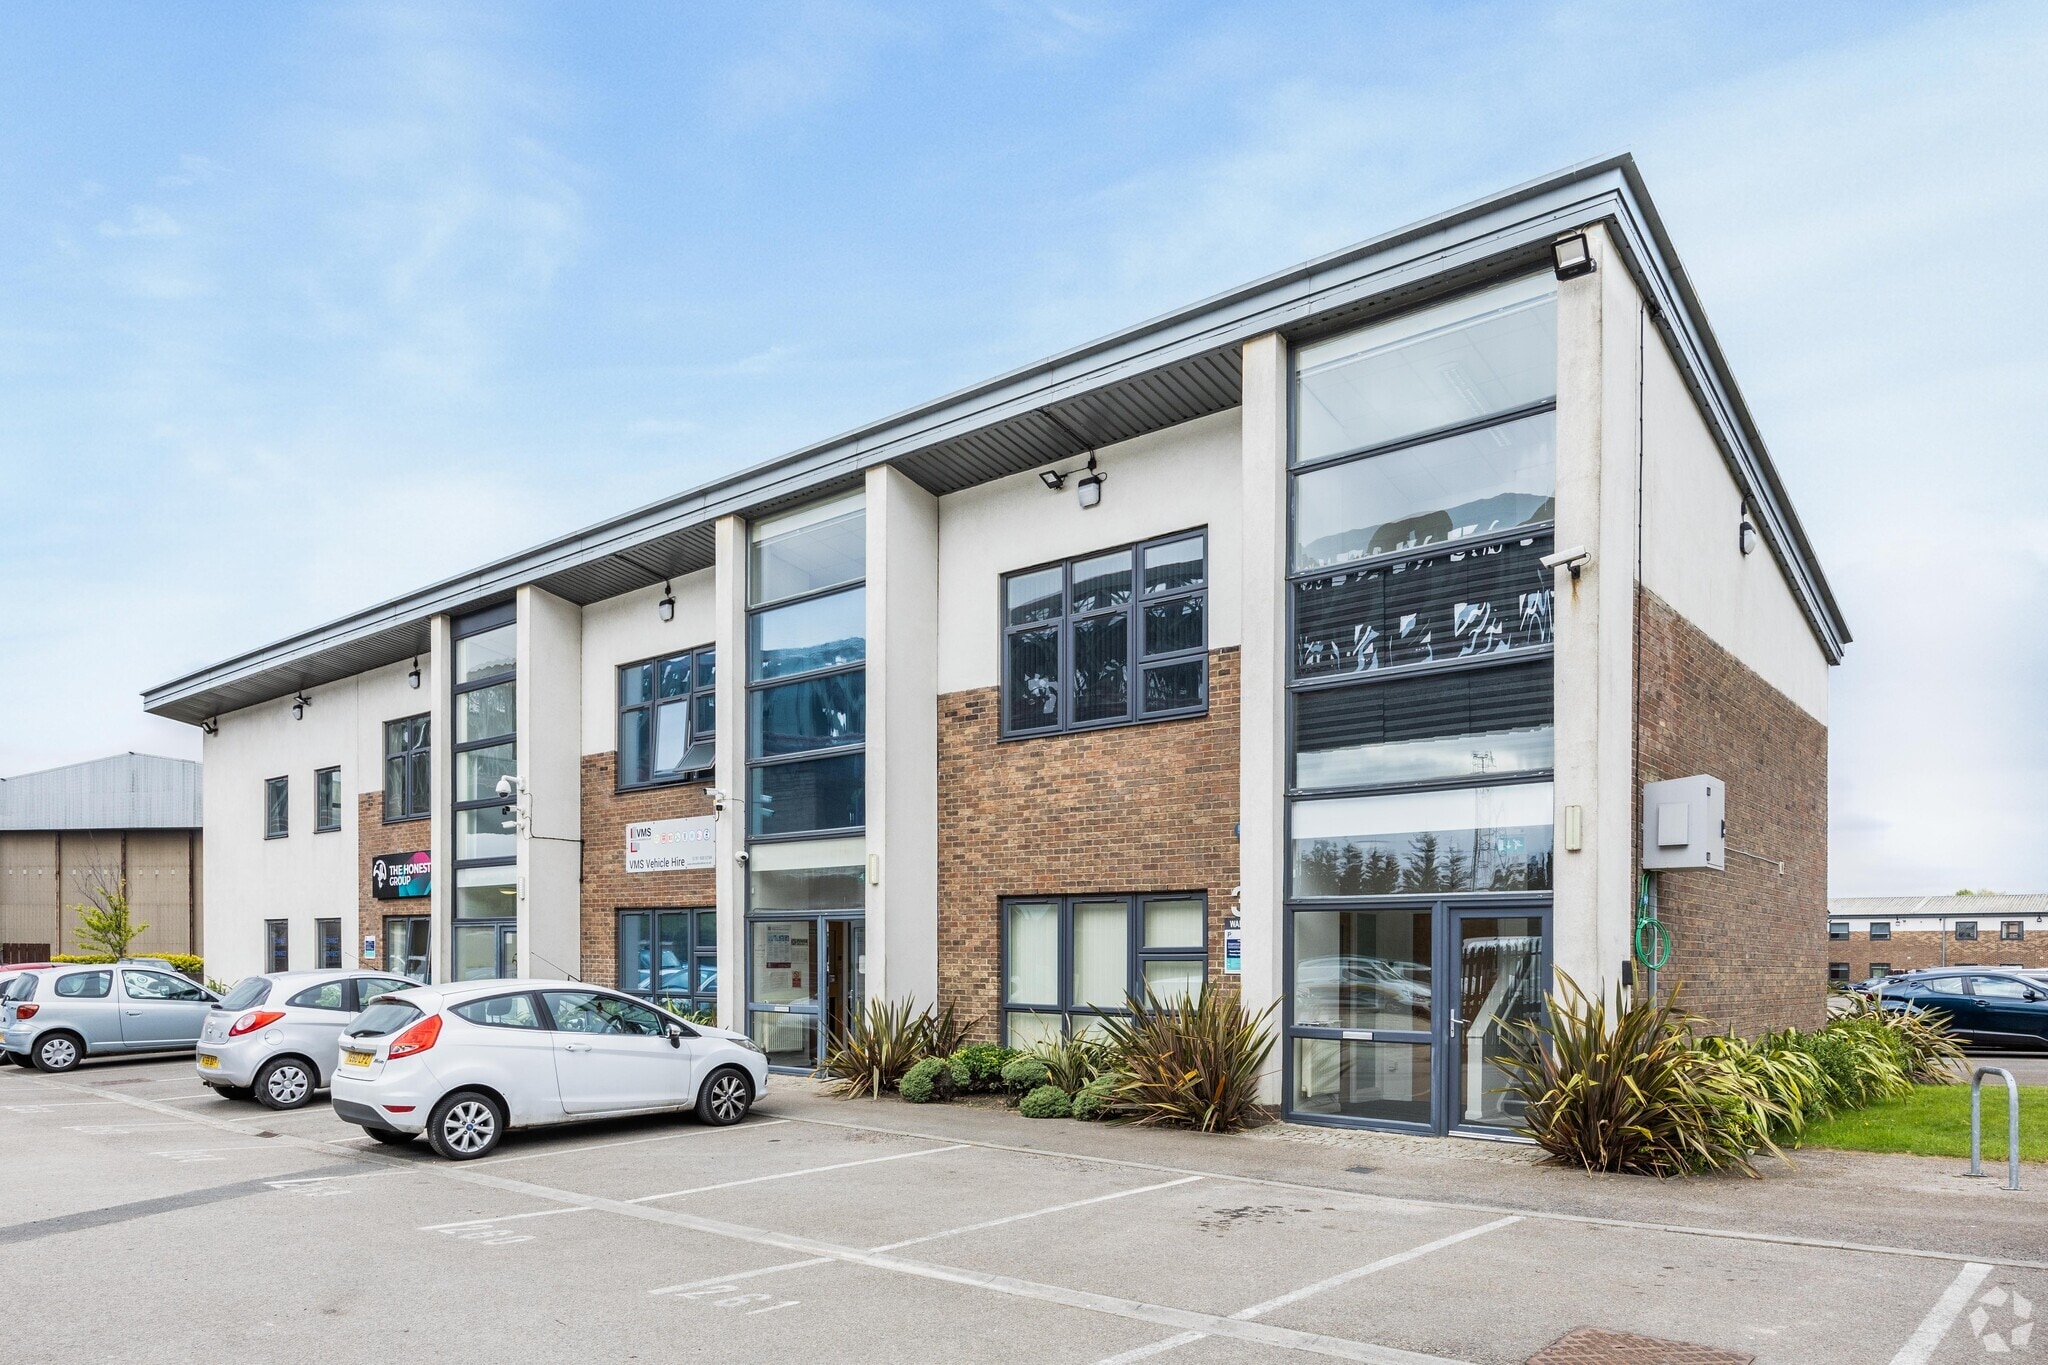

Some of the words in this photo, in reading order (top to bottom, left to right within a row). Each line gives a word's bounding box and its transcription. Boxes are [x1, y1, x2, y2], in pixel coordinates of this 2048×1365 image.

[636, 828, 652, 838] VMS
[389, 864, 403, 876] THE
[403, 862, 432, 875] HONEST
[629, 860, 645, 870] VMS
[646, 857, 670, 869] Vehicle
[671, 856, 686, 867] Hire
[389, 875, 412, 887] GROUP
